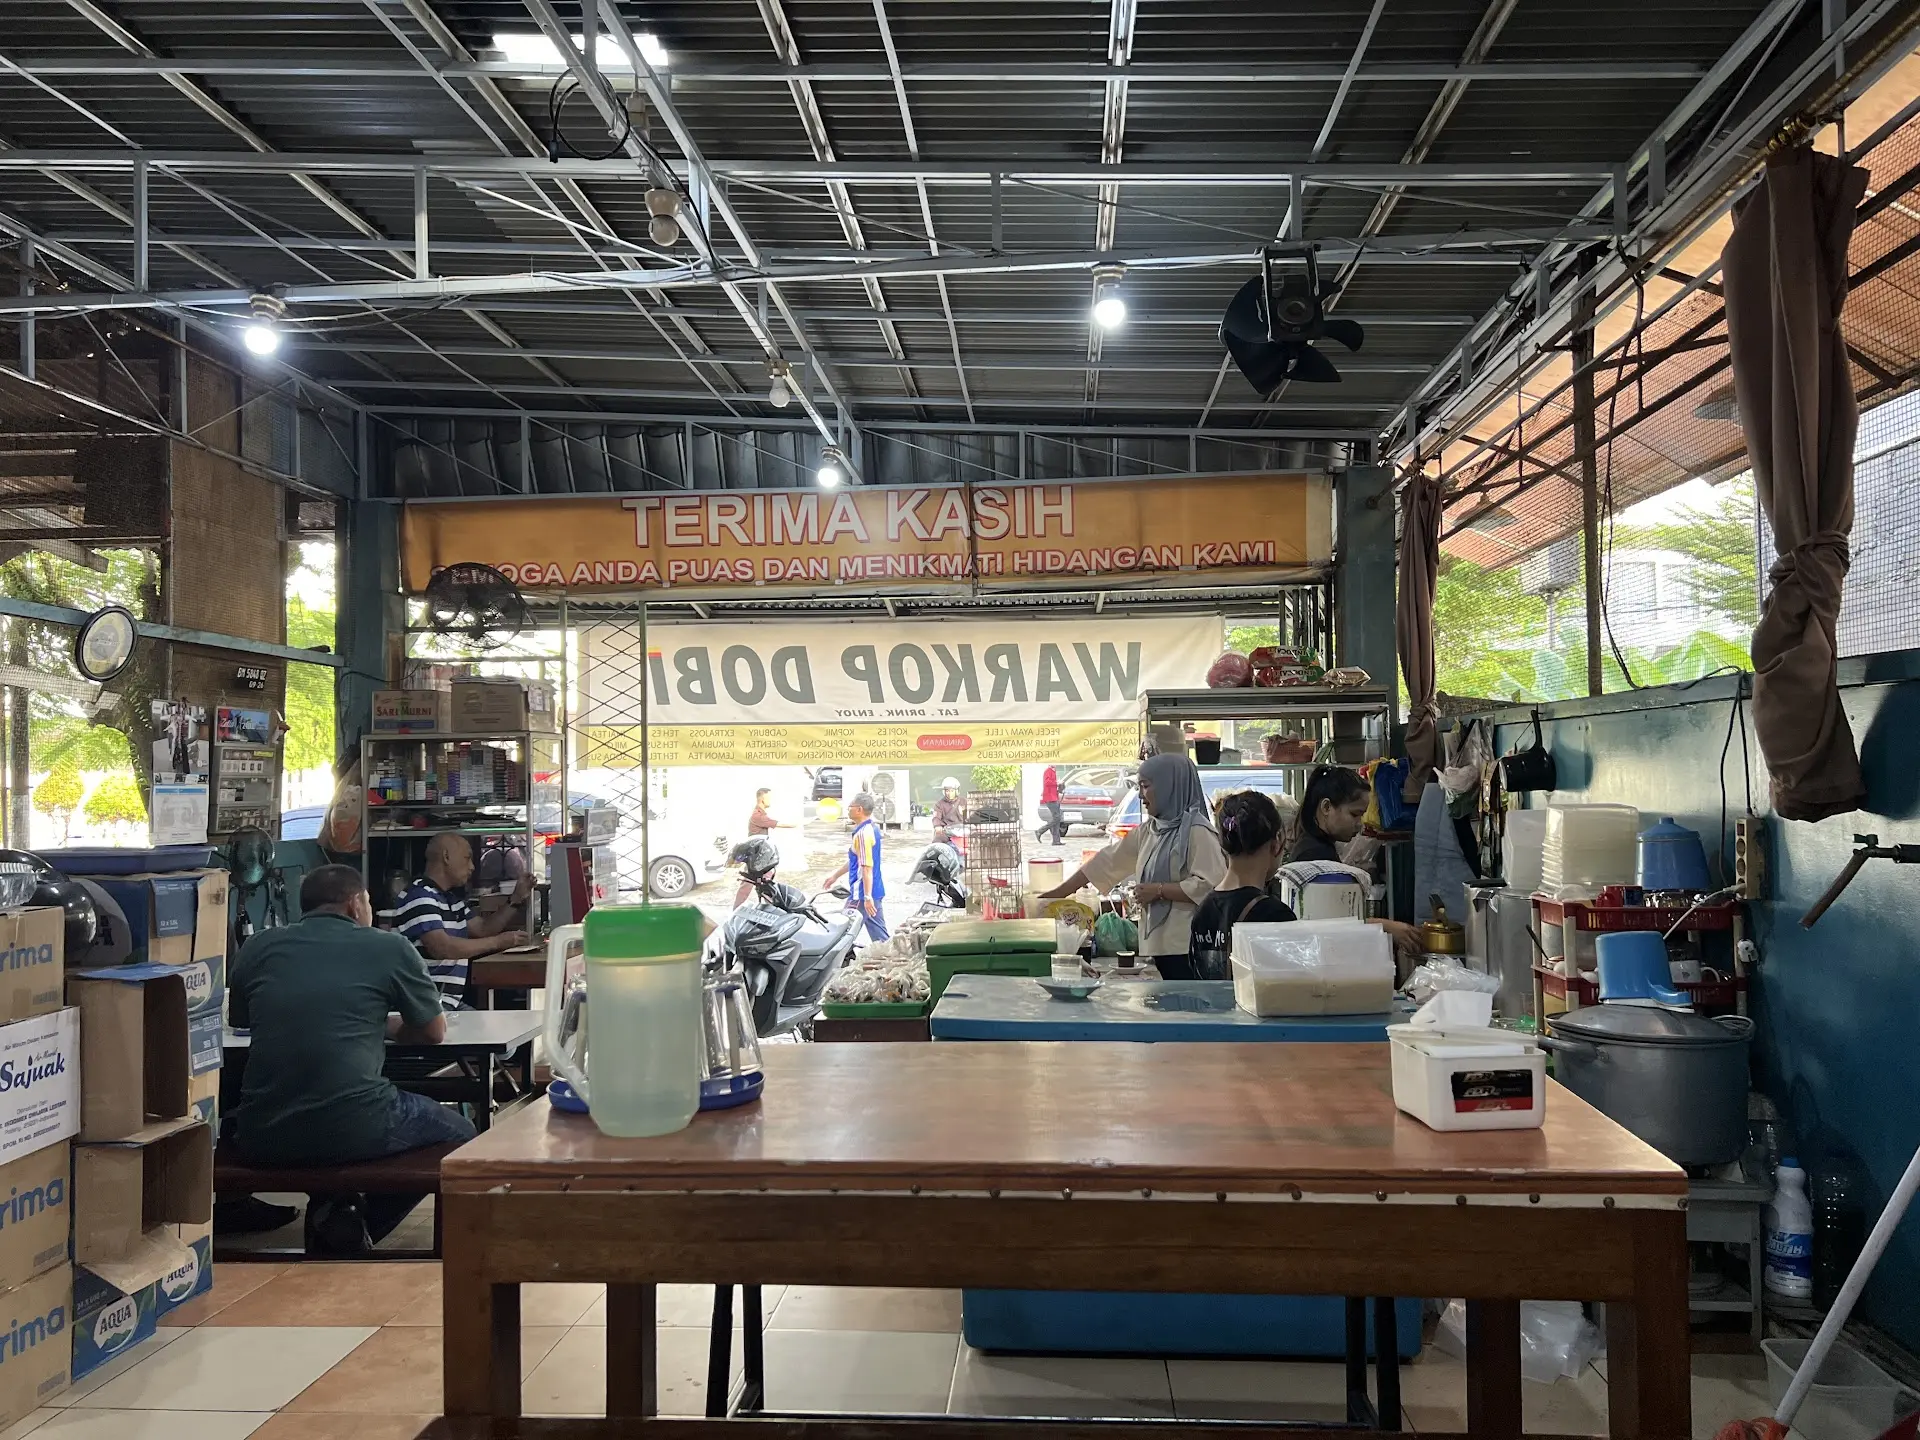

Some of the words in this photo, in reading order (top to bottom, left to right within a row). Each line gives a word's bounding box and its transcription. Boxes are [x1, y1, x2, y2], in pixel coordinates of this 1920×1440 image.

[621, 492, 870, 549] TERIMA
[886, 484, 1075, 542] KASIH
[570, 560, 662, 585] ANDA
[668, 558, 756, 584] PUAS
[762, 556, 829, 581] DAN
[839, 551, 1004, 581] MENIKMATI
[1013, 544, 1184, 574] HIDANGAN
[1192, 539, 1277, 567] KAMI
[376, 706, 398, 717] SARI
[400, 705, 432, 716] MURNI
[0, 1052, 65, 1093] Sajuak
[99, 1304, 132, 1335] AQUA
